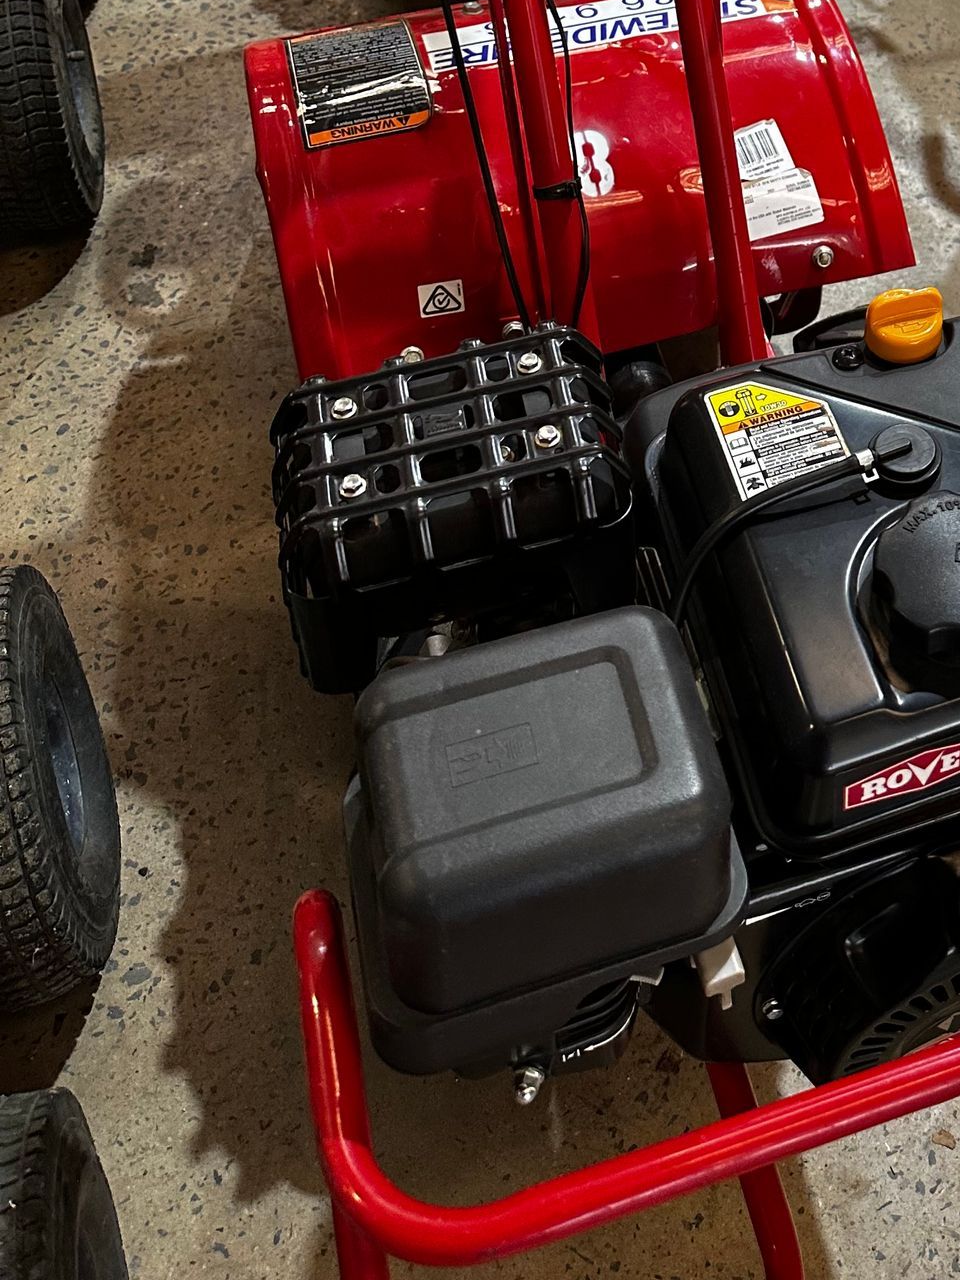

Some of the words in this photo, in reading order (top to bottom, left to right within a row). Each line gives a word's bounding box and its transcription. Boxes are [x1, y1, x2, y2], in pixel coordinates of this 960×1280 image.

[330, 120, 396, 138] WARNING
[749, 406, 803, 426] WARNING
[902, 507, 937, 534] MAX.
